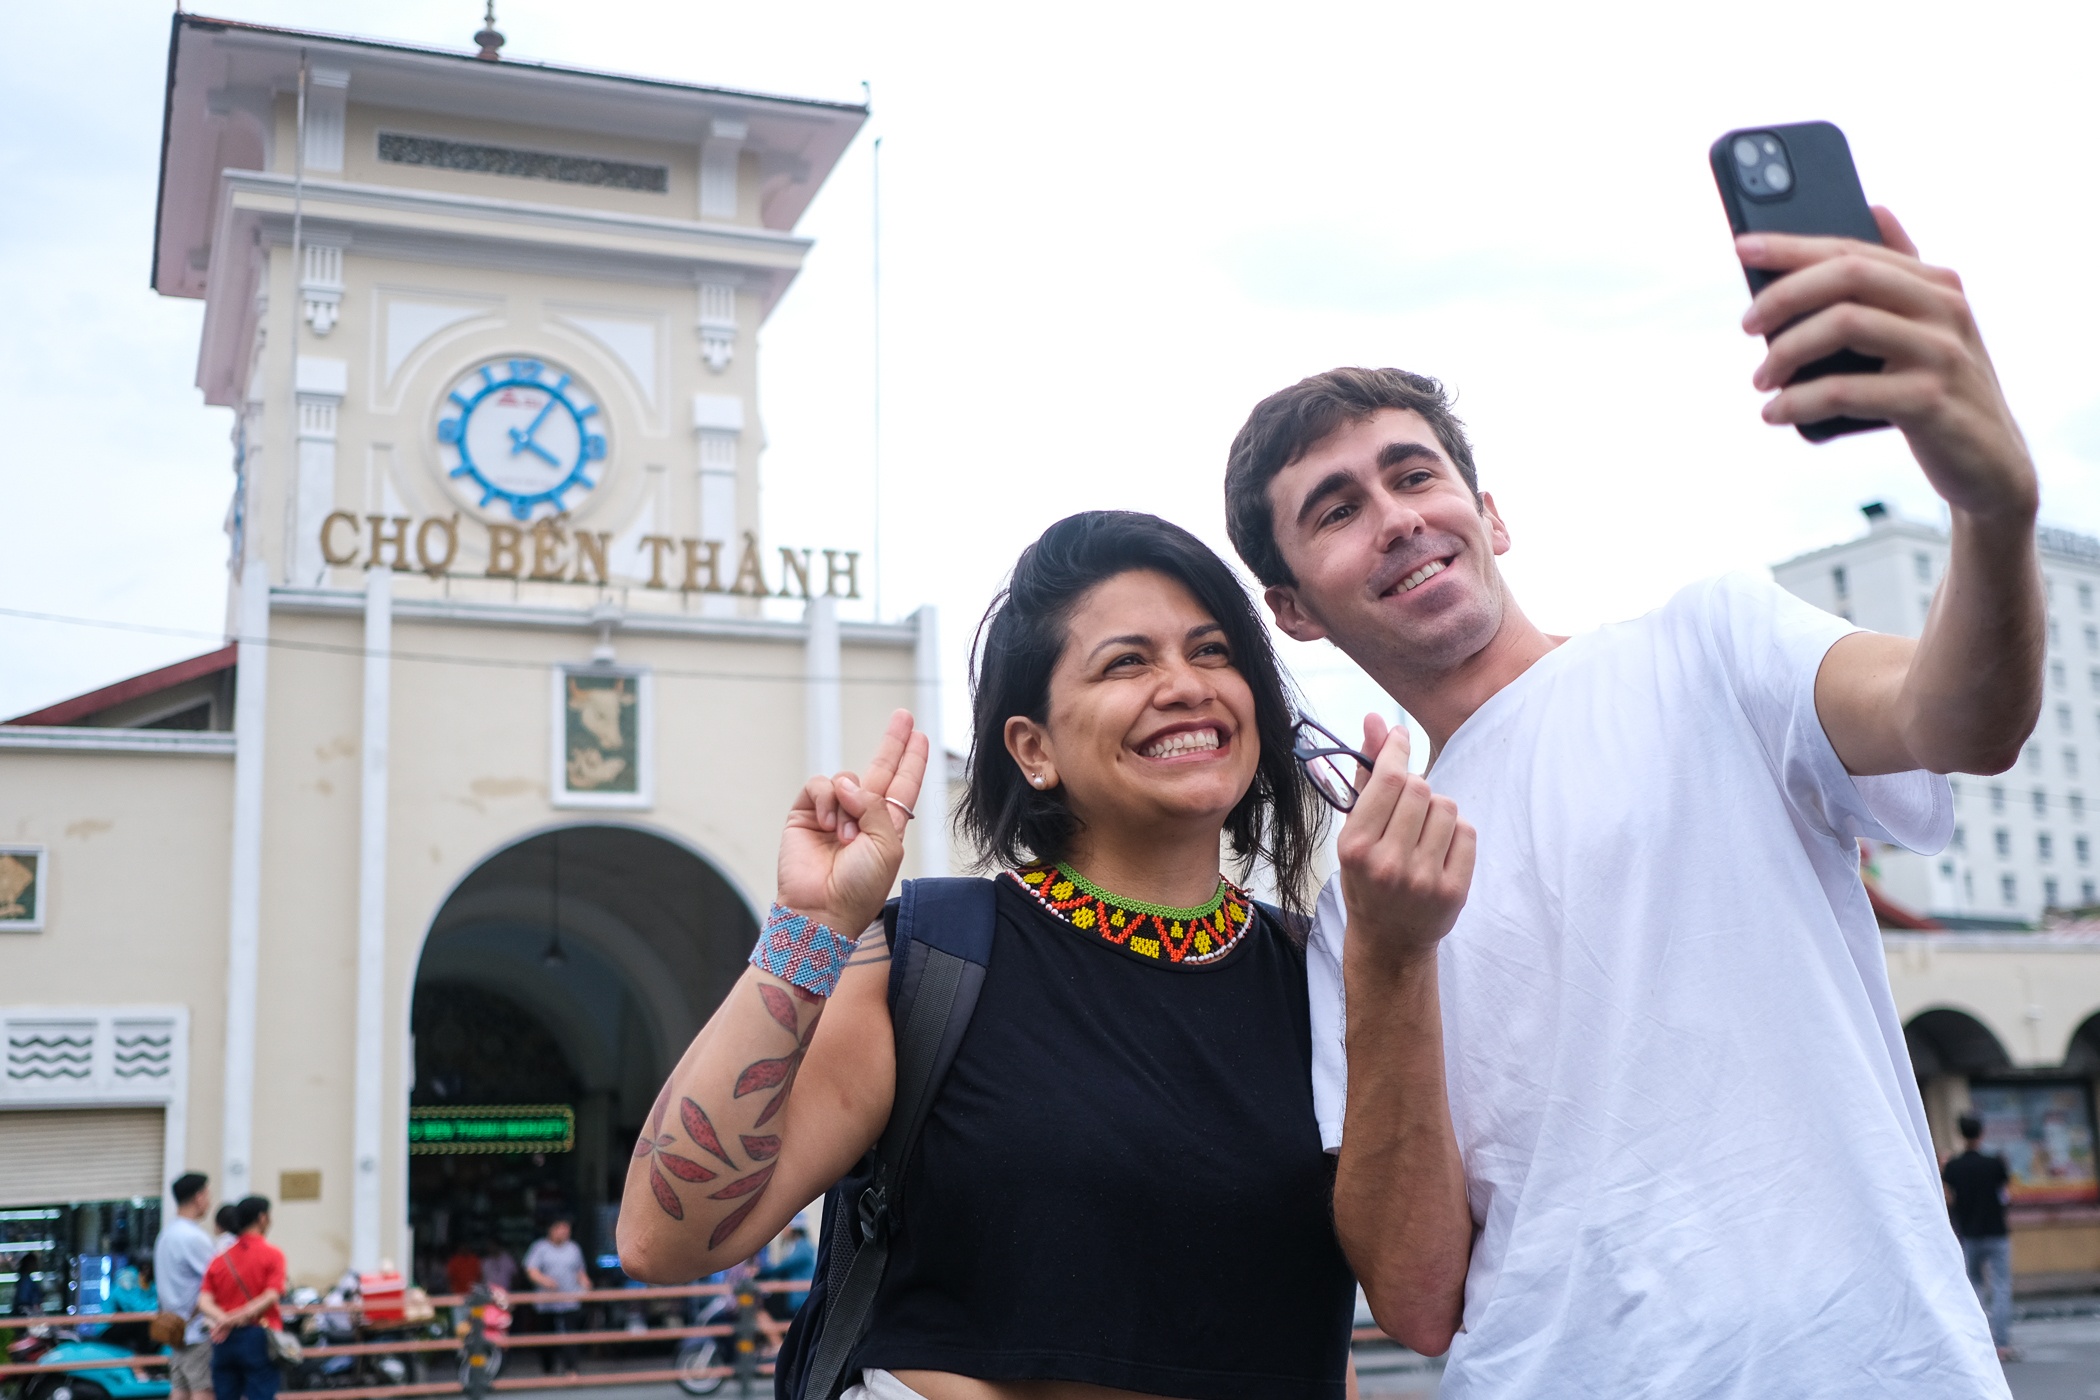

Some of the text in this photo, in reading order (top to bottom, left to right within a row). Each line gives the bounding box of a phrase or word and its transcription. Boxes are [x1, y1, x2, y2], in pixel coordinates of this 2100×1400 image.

[320, 511, 861, 599] CHỢ BẾN THÀNH
